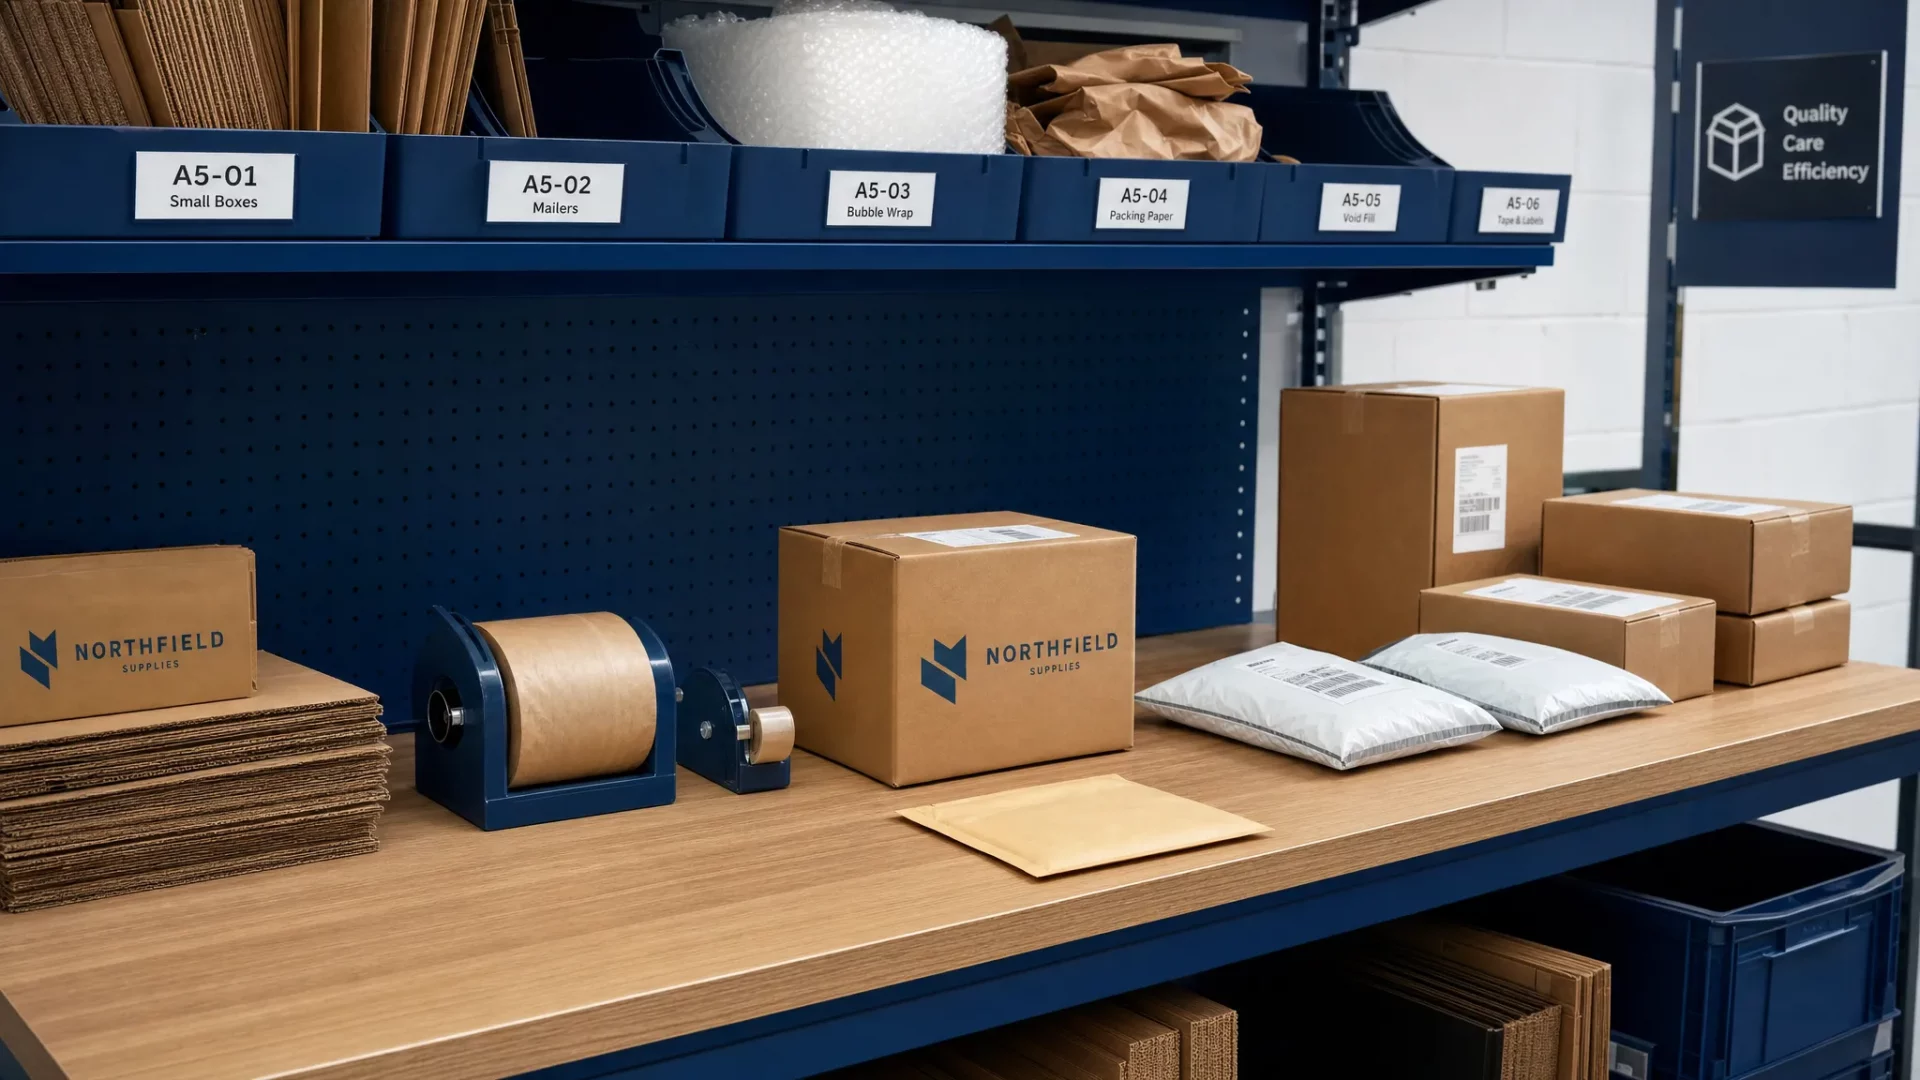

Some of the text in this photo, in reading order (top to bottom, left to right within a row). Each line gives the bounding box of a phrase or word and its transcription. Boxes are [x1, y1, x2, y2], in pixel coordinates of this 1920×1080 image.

[1783, 104, 1848, 126] Quality
[1782, 134, 1825, 152] Care
[173, 165, 257, 186] A5-01
[1782, 162, 1870, 184] Efficiency
[522, 175, 591, 194] A5-02
[855, 182, 910, 199] A5-03
[170, 195, 258, 208] Small Boxes
[1121, 187, 1167, 203] A5-04
[1342, 193, 1381, 207] A5-05
[532, 202, 579, 214] Mailers
[1506, 197, 1540, 210] A5-06
[847, 206, 913, 220] Bubble Wrap
[1110, 210, 1174, 223] Packing Paper
[1343, 213, 1375, 223] Void Fill
[1497, 215, 1514, 226] Tape
[1522, 216, 1544, 225] Labels
[75, 631, 224, 661] NORTHFIELD
[986, 632, 1118, 665] NORTHFIELD
[122, 659, 180, 673] SUPPLIES
[1029, 661, 1081, 676] SUPPLIES
